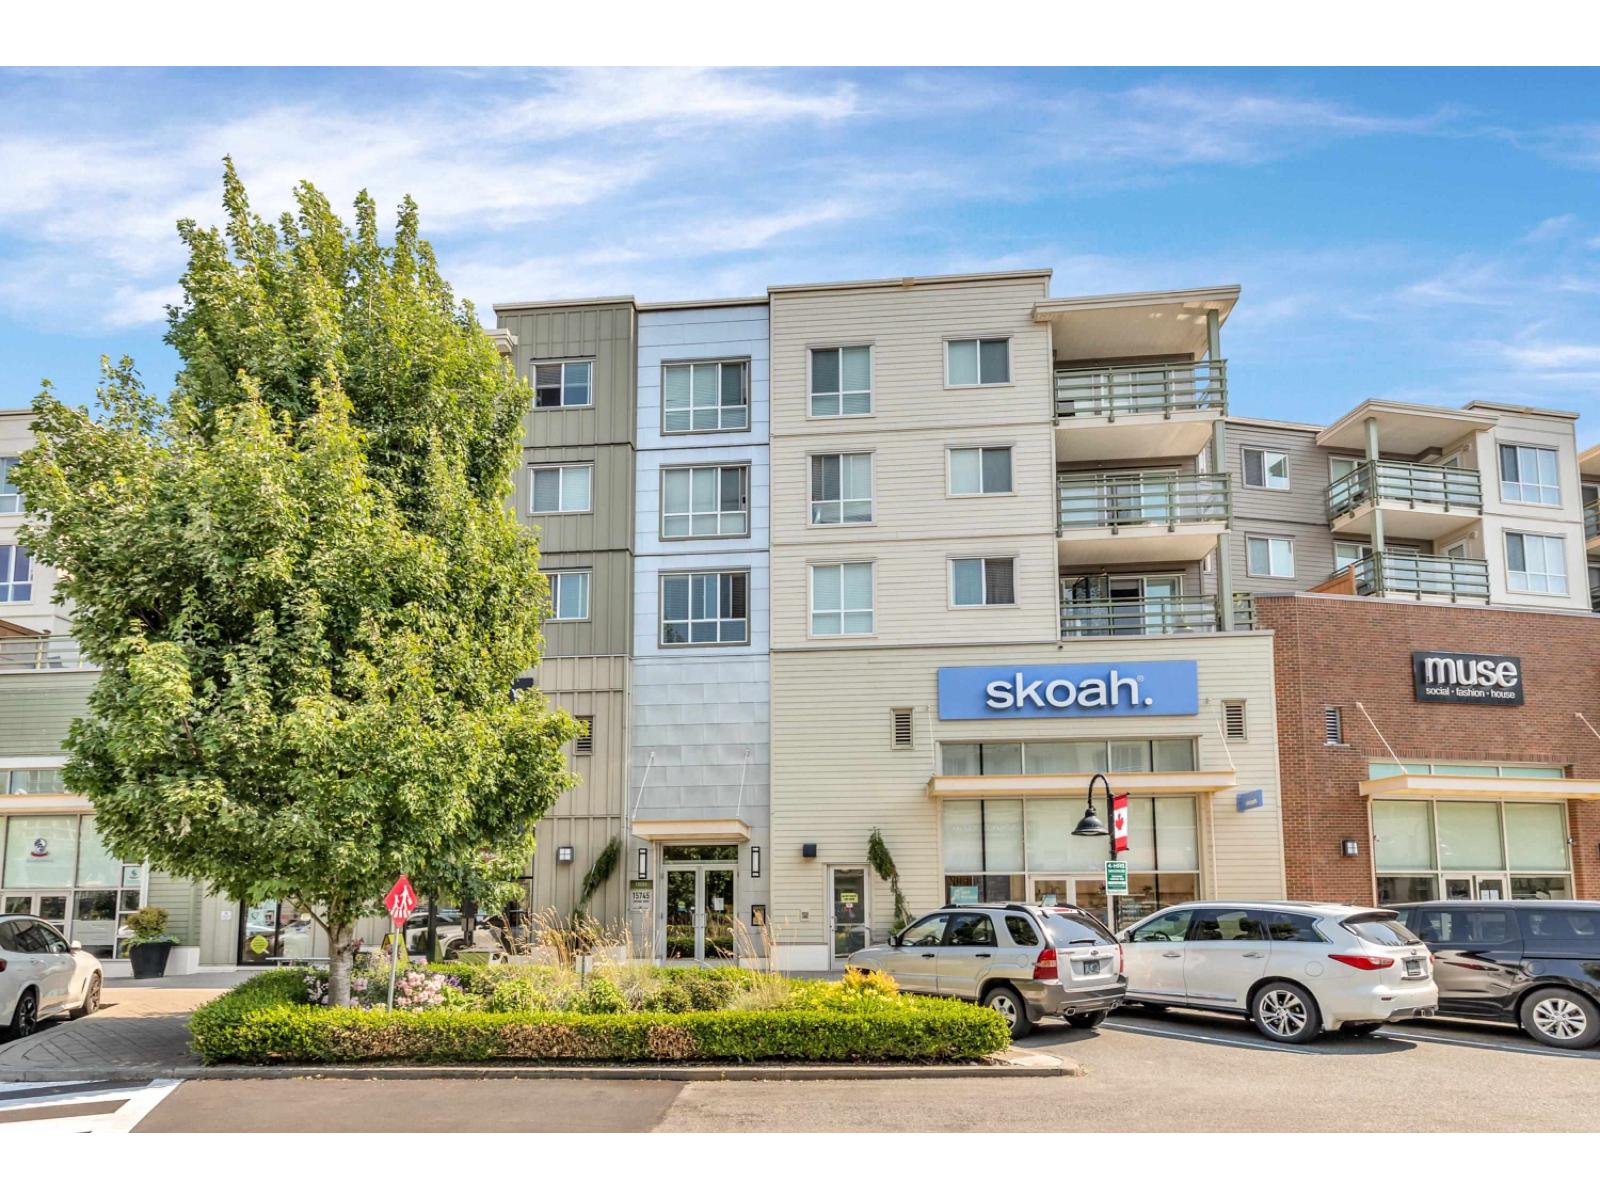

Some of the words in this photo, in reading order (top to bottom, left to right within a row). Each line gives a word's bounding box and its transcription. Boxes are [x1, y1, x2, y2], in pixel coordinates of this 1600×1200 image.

[1424, 657, 1518, 688] muse
[1425, 687, 1450, 696] social
[1455, 687, 1485, 698] fashion
[1490, 689, 1516, 699] house
